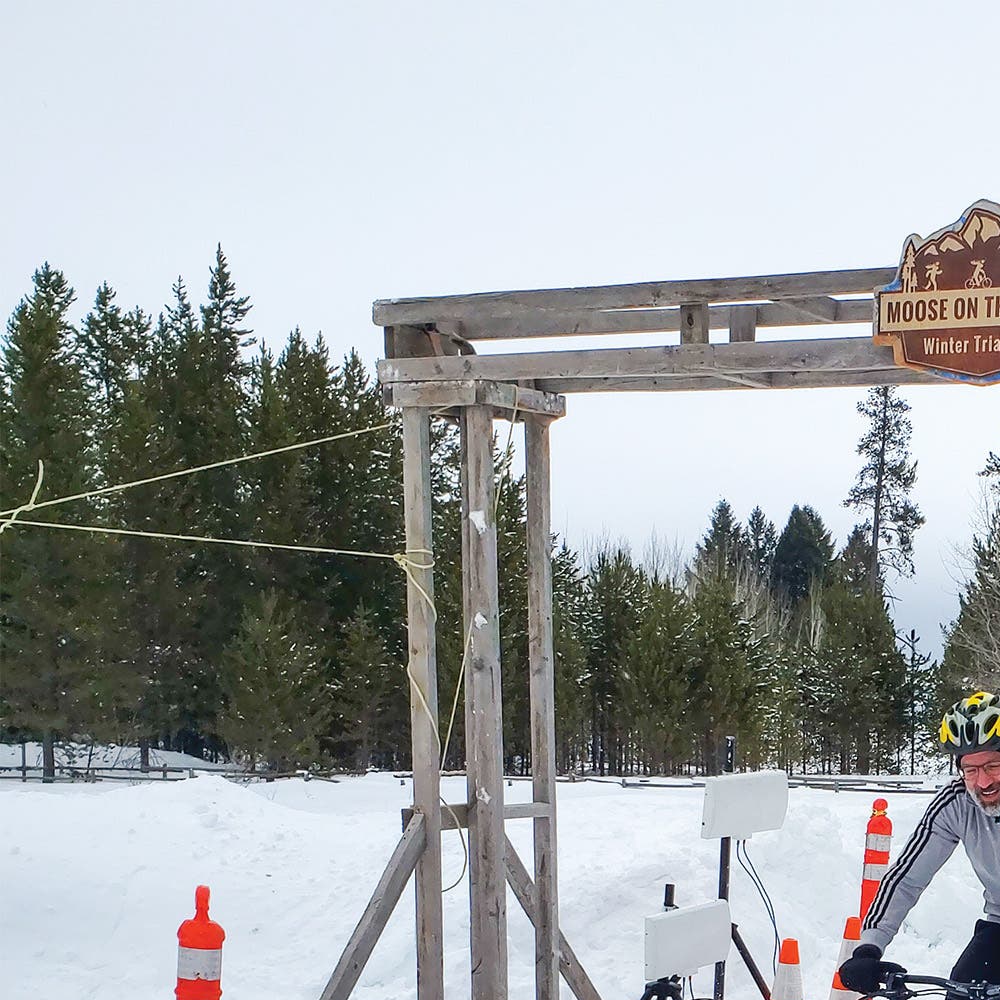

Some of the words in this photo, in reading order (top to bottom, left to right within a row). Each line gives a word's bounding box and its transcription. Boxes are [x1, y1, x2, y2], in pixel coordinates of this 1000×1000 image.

[887, 298, 948, 324] MOOSE
[954, 296, 979, 320] ON
[923, 337, 969, 355] Winter
